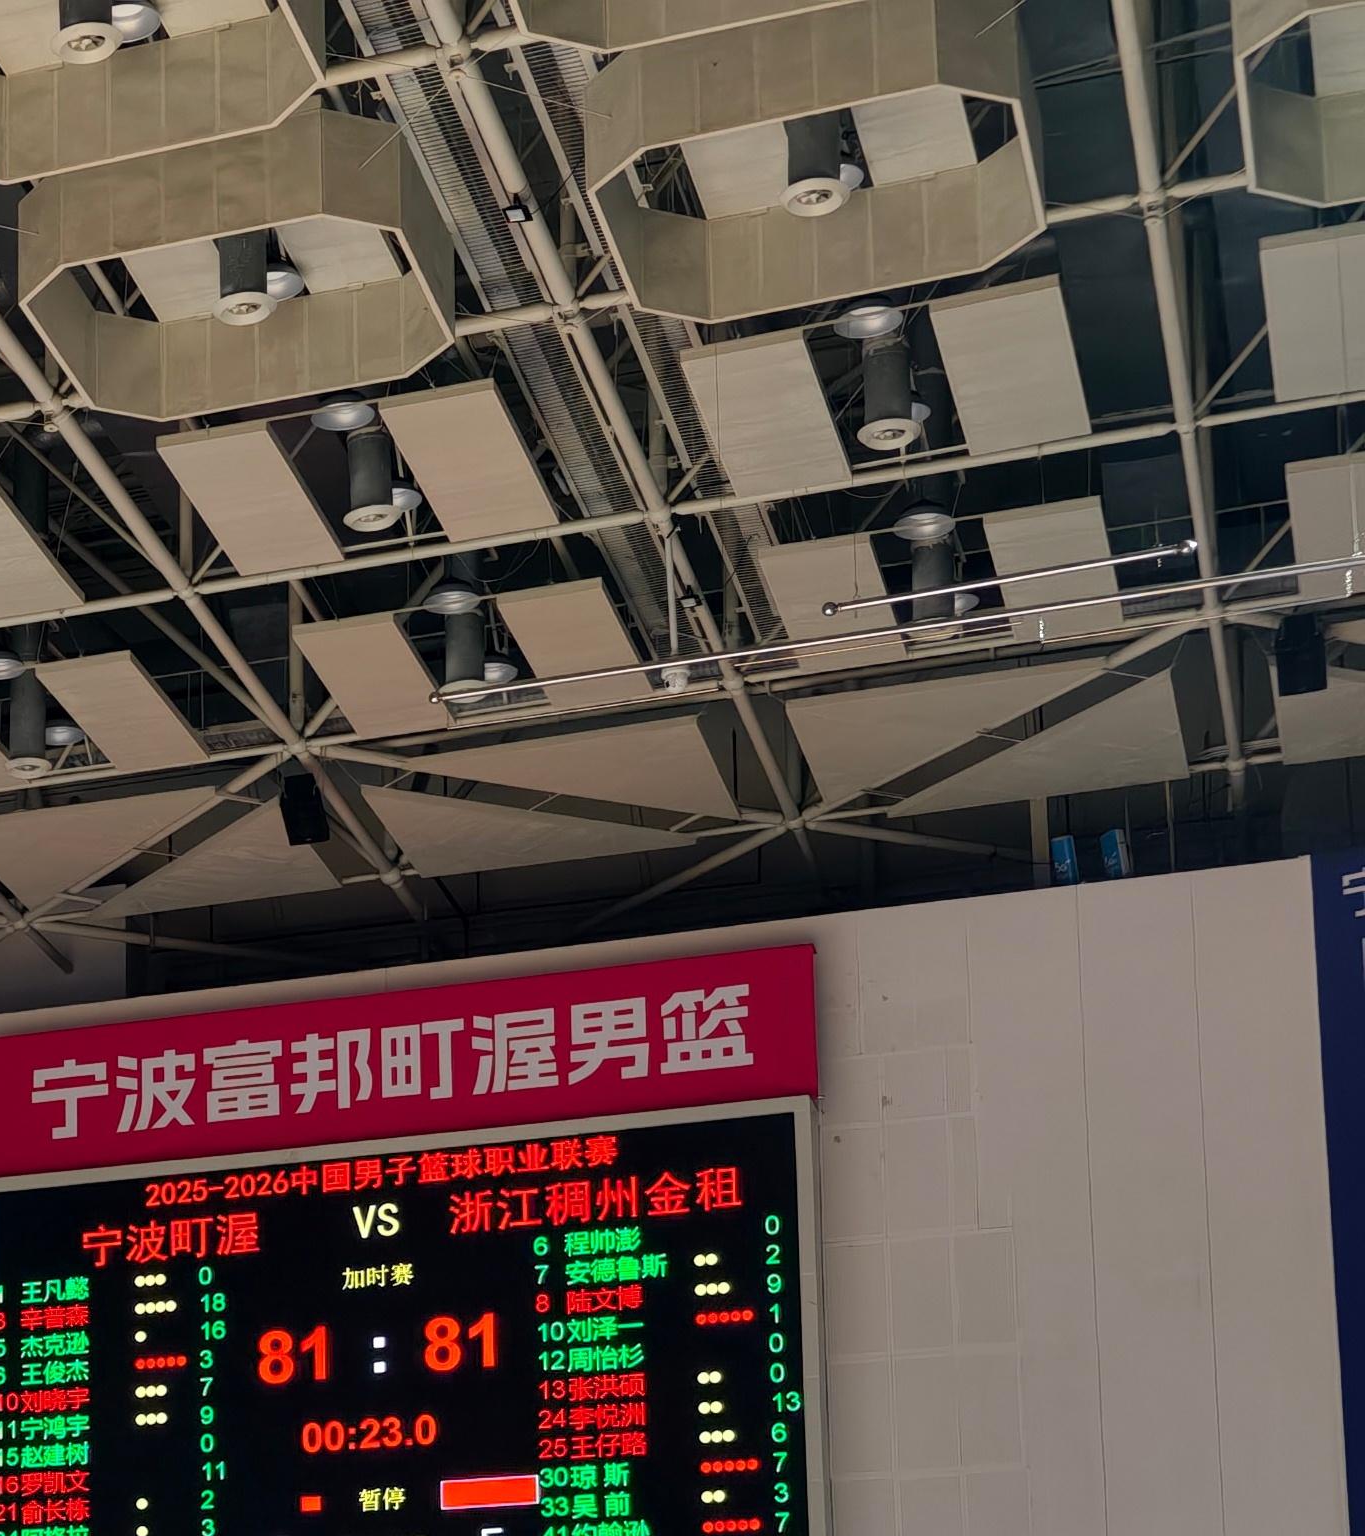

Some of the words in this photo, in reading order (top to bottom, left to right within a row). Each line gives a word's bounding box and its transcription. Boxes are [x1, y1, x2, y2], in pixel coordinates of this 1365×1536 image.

[30, 982, 755, 1141] 宁波富邦町渥男篮
[144, 1134, 618, 1208] 2025-2026中国男子篮球职业联赛
[81, 1211, 261, 1269] 宁波町渥
[352, 1202, 401, 1239] VS
[447, 1166, 742, 1236] 浙江稠州金租
[533, 1237, 548, 1256] 6
[565, 1226, 641, 1256] 程帅澎
[765, 1215, 780, 1235] 0
[199, 1266, 212, 1285] 0
[341, 1262, 414, 1290] 加时赛
[534, 1265, 548, 1284] 7
[565, 1253, 667, 1285] 安德鲁斯
[765, 1244, 780, 1264] 2
[21, 1305, 89, 1330] 辛普森
[200, 1293, 226, 1312] 18
[535, 1294, 550, 1313] 8
[566, 1285, 643, 1314] 陆文博
[766, 1273, 781, 1293] 9
[21, 1332, 89, 1357] 杰克逊
[200, 1321, 226, 1340] 16
[538, 1322, 564, 1342] 10
[567, 1316, 644, 1343] 刘泽一
[769, 1303, 780, 1323] 1
[258, 1324, 328, 1385] 81
[423, 1311, 497, 1372] 81
[539, 1351, 565, 1370] 12
[567, 1343, 645, 1372] 周怡杉
[769, 1333, 784, 1353] 0
[21, 1360, 89, 1385] 王俊杰
[200, 1350, 213, 1368] 3
[539, 1380, 565, 1399] 13
[568, 1372, 645, 1400] 张洪硕
[770, 1363, 785, 1383] 0
[21, 1388, 90, 1413] 刘晓宇
[200, 1377, 213, 1396] 7
[538, 1410, 565, 1429] 24
[569, 1403, 646, 1430] 李悦洲
[772, 1391, 801, 1412] 13
[21, 1415, 90, 1441] 宁鸿宇
[200, 1406, 214, 1425] 9
[301, 1413, 437, 1454] 00:23.0
[539, 1439, 567, 1459] 25
[570, 1431, 648, 1460] 王仔路
[771, 1423, 787, 1443] 6
[21, 1441, 89, 1468] 赵建树
[200, 1433, 214, 1452] 0
[21, 1470, 90, 1496] 罗凯文
[201, 1461, 226, 1480] 11
[540, 1468, 568, 1488] 30
[570, 1462, 630, 1489] 琼斯
[773, 1452, 787, 1472] 7
[21, 1499, 90, 1525] 俞长栋
[201, 1490, 214, 1509] 2
[358, 1487, 406, 1512] 暂停
[540, 1497, 568, 1517] 33
[572, 1491, 630, 1519] 吴前
[774, 1483, 789, 1503] 3
[775, 1511, 790, 1533] 7
